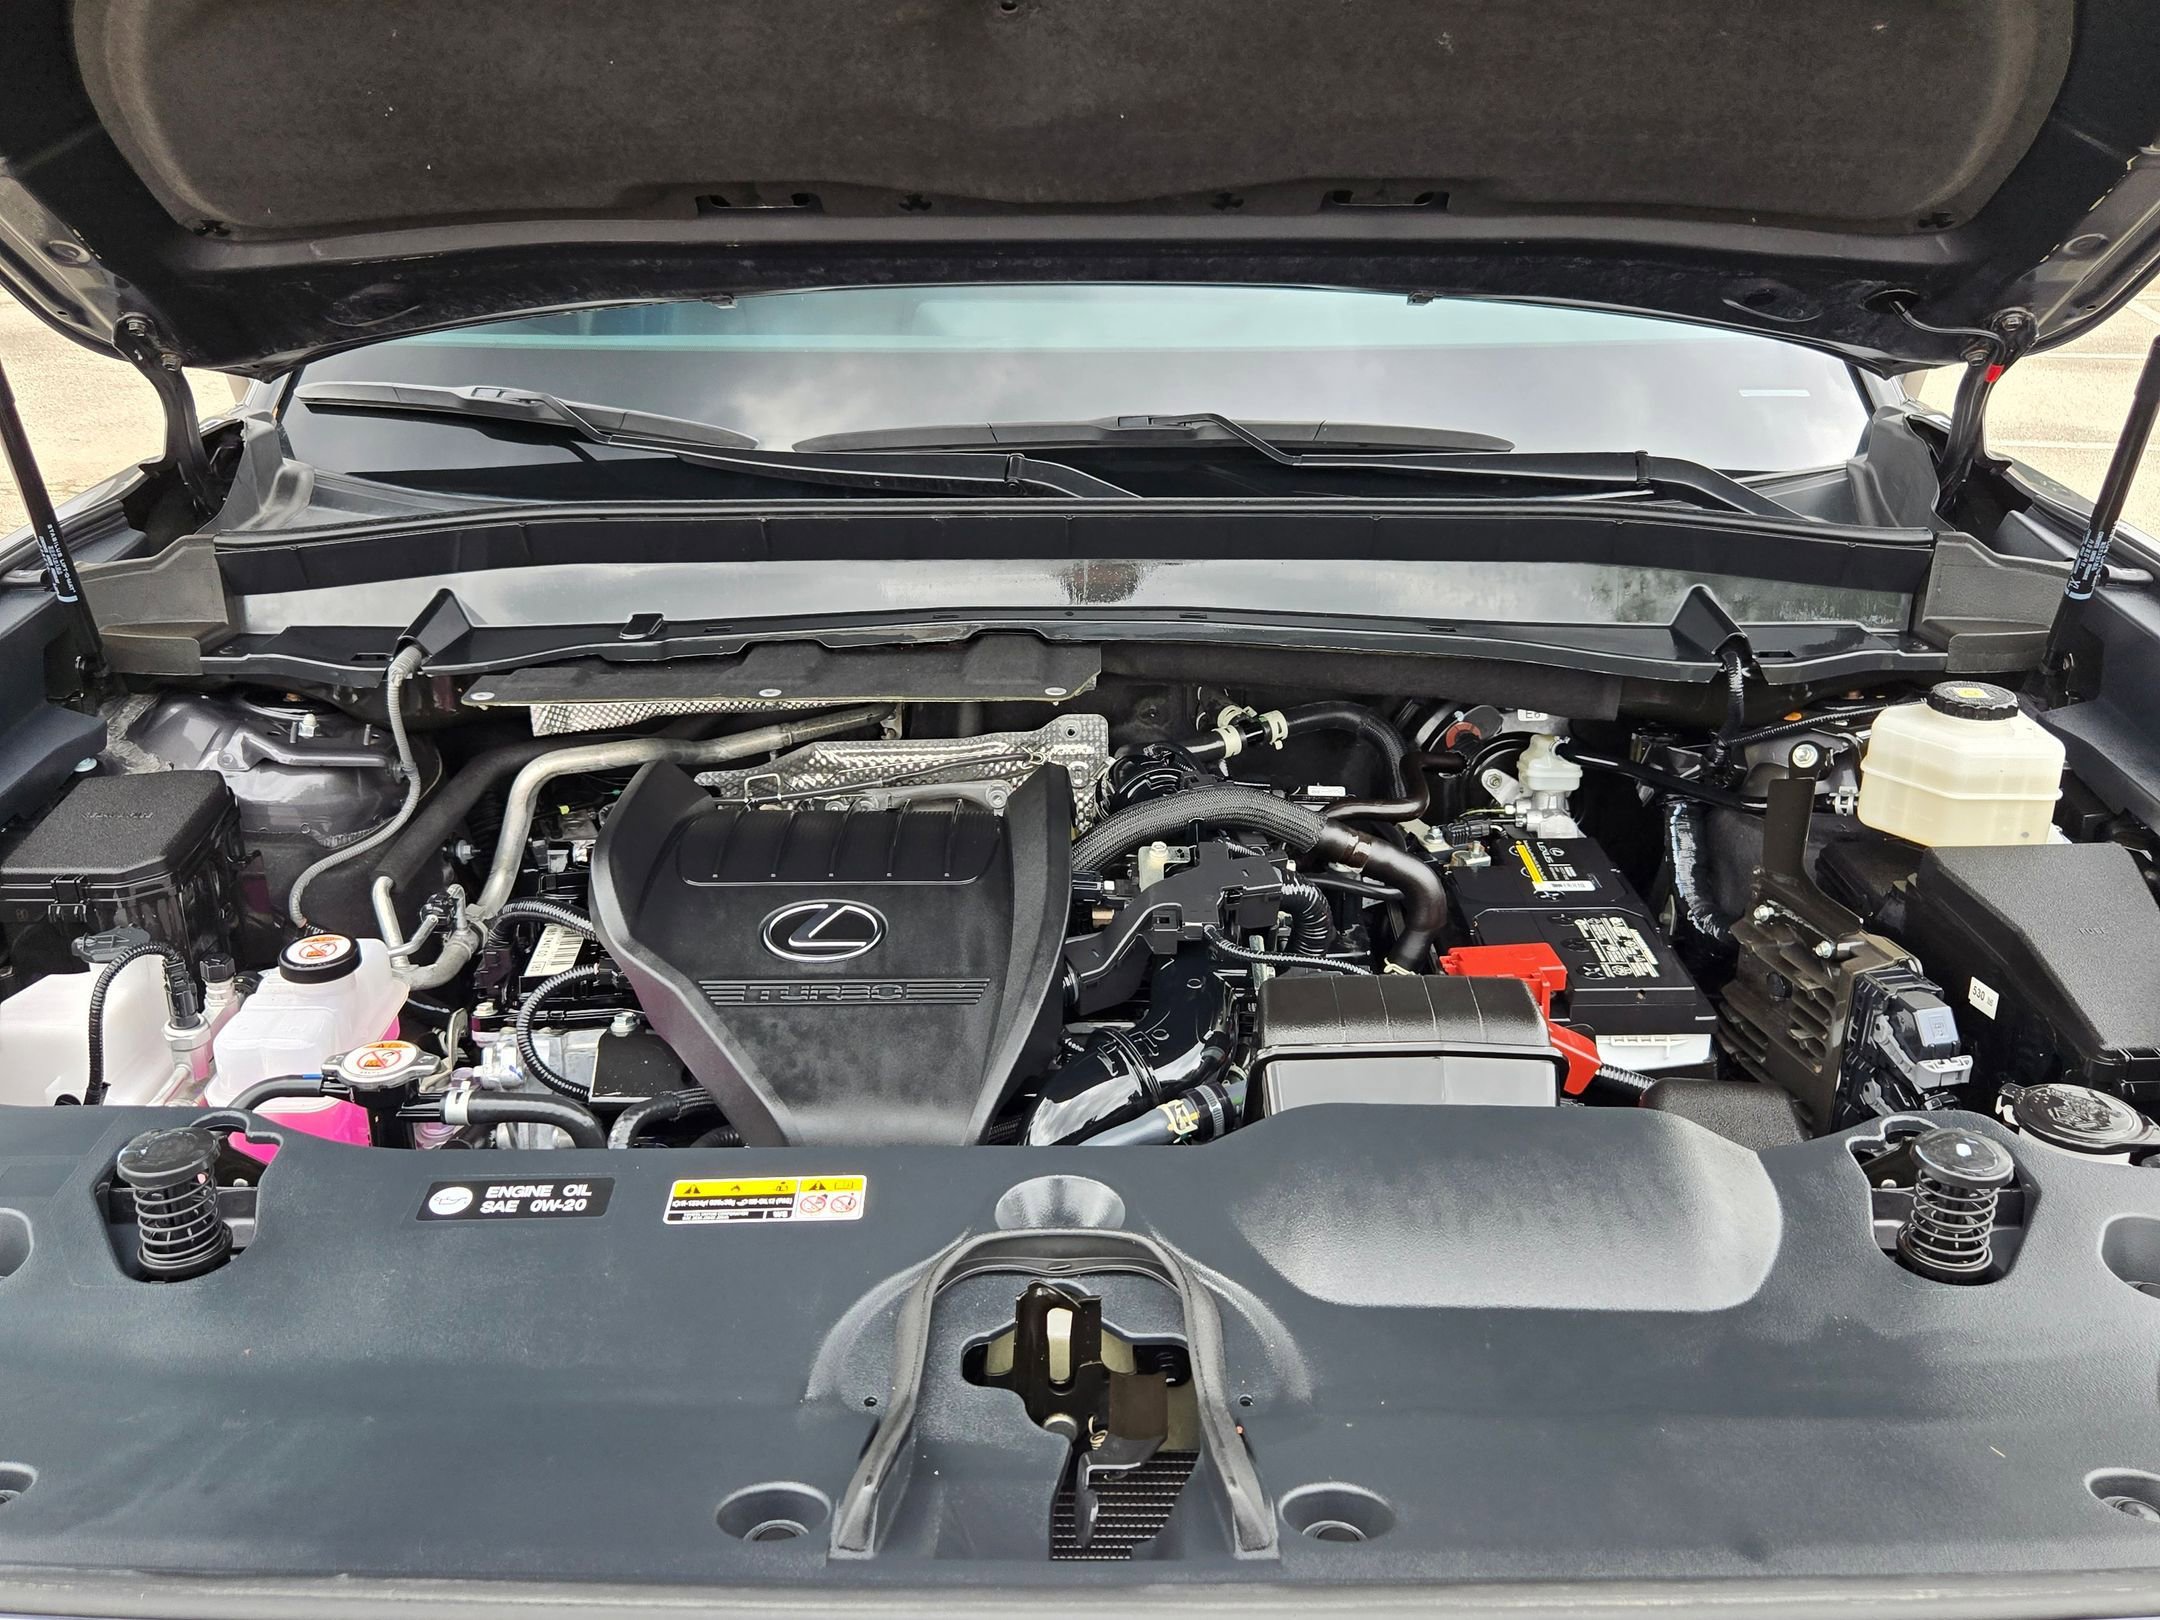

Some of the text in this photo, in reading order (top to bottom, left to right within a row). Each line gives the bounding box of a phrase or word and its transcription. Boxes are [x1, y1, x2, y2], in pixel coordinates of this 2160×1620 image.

[47, 523, 63, 558] STABILUS
[1536, 841, 1554, 863] LEXUS
[749, 984, 904, 1001] TURBO
[1972, 985, 1986, 1001] 530
[485, 1183, 593, 1198] ENGINE OIL
[480, 1198, 587, 1213] SAE 0W-20
